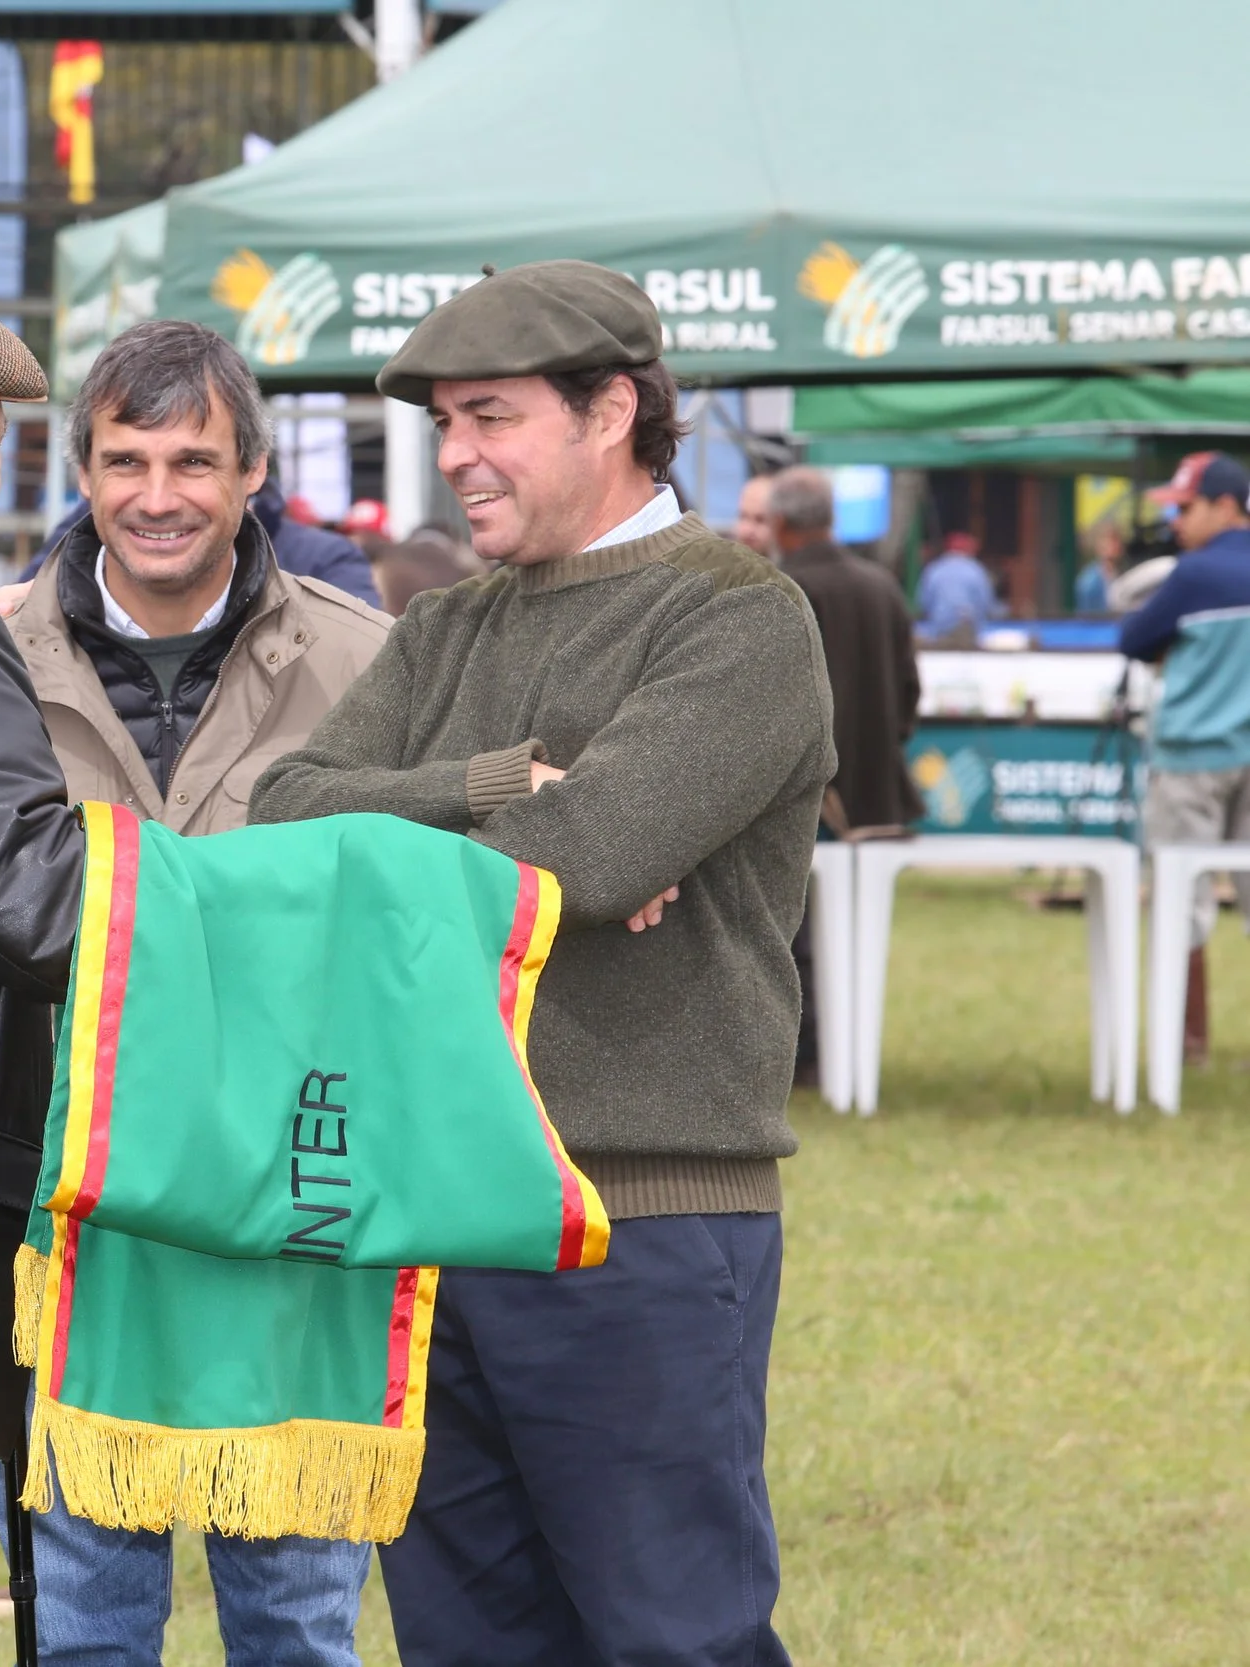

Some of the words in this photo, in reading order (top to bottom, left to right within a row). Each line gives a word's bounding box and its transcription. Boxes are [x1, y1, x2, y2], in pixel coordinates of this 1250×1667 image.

[624, 268, 777, 314] RSUL
[940, 257, 1167, 306] SISTEMA
[940, 313, 1058, 347] FARSUL
[279, 1069, 351, 1262] INTER
